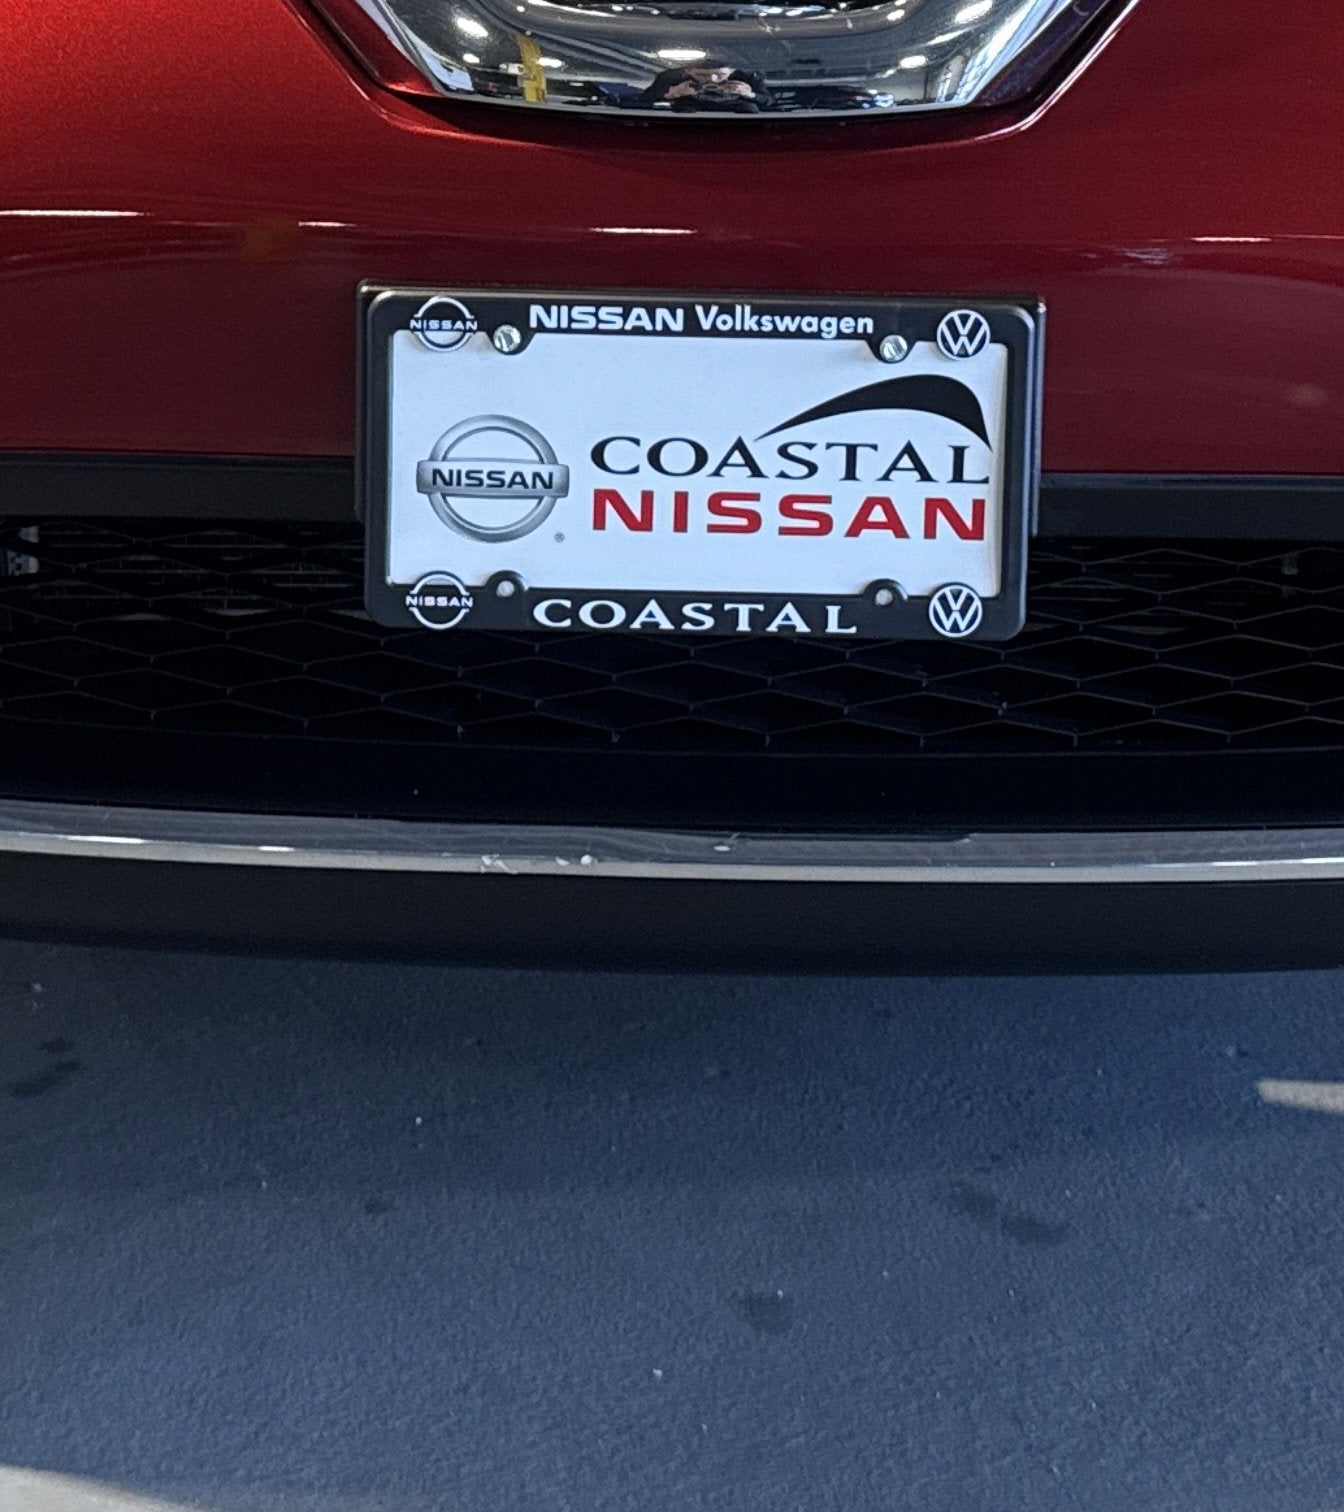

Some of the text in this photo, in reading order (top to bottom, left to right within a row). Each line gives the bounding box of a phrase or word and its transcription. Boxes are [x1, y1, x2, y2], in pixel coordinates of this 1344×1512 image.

[409, 319, 478, 331] NISSAN
[529, 304, 874, 339] NISSAN Volkswagen
[590, 435, 990, 484] COASTAL
[431, 468, 554, 490] NISSAN
[592, 488, 986, 541] NISSAN
[405, 594, 474, 609] NISSAN
[532, 598, 857, 634] COASTAL
